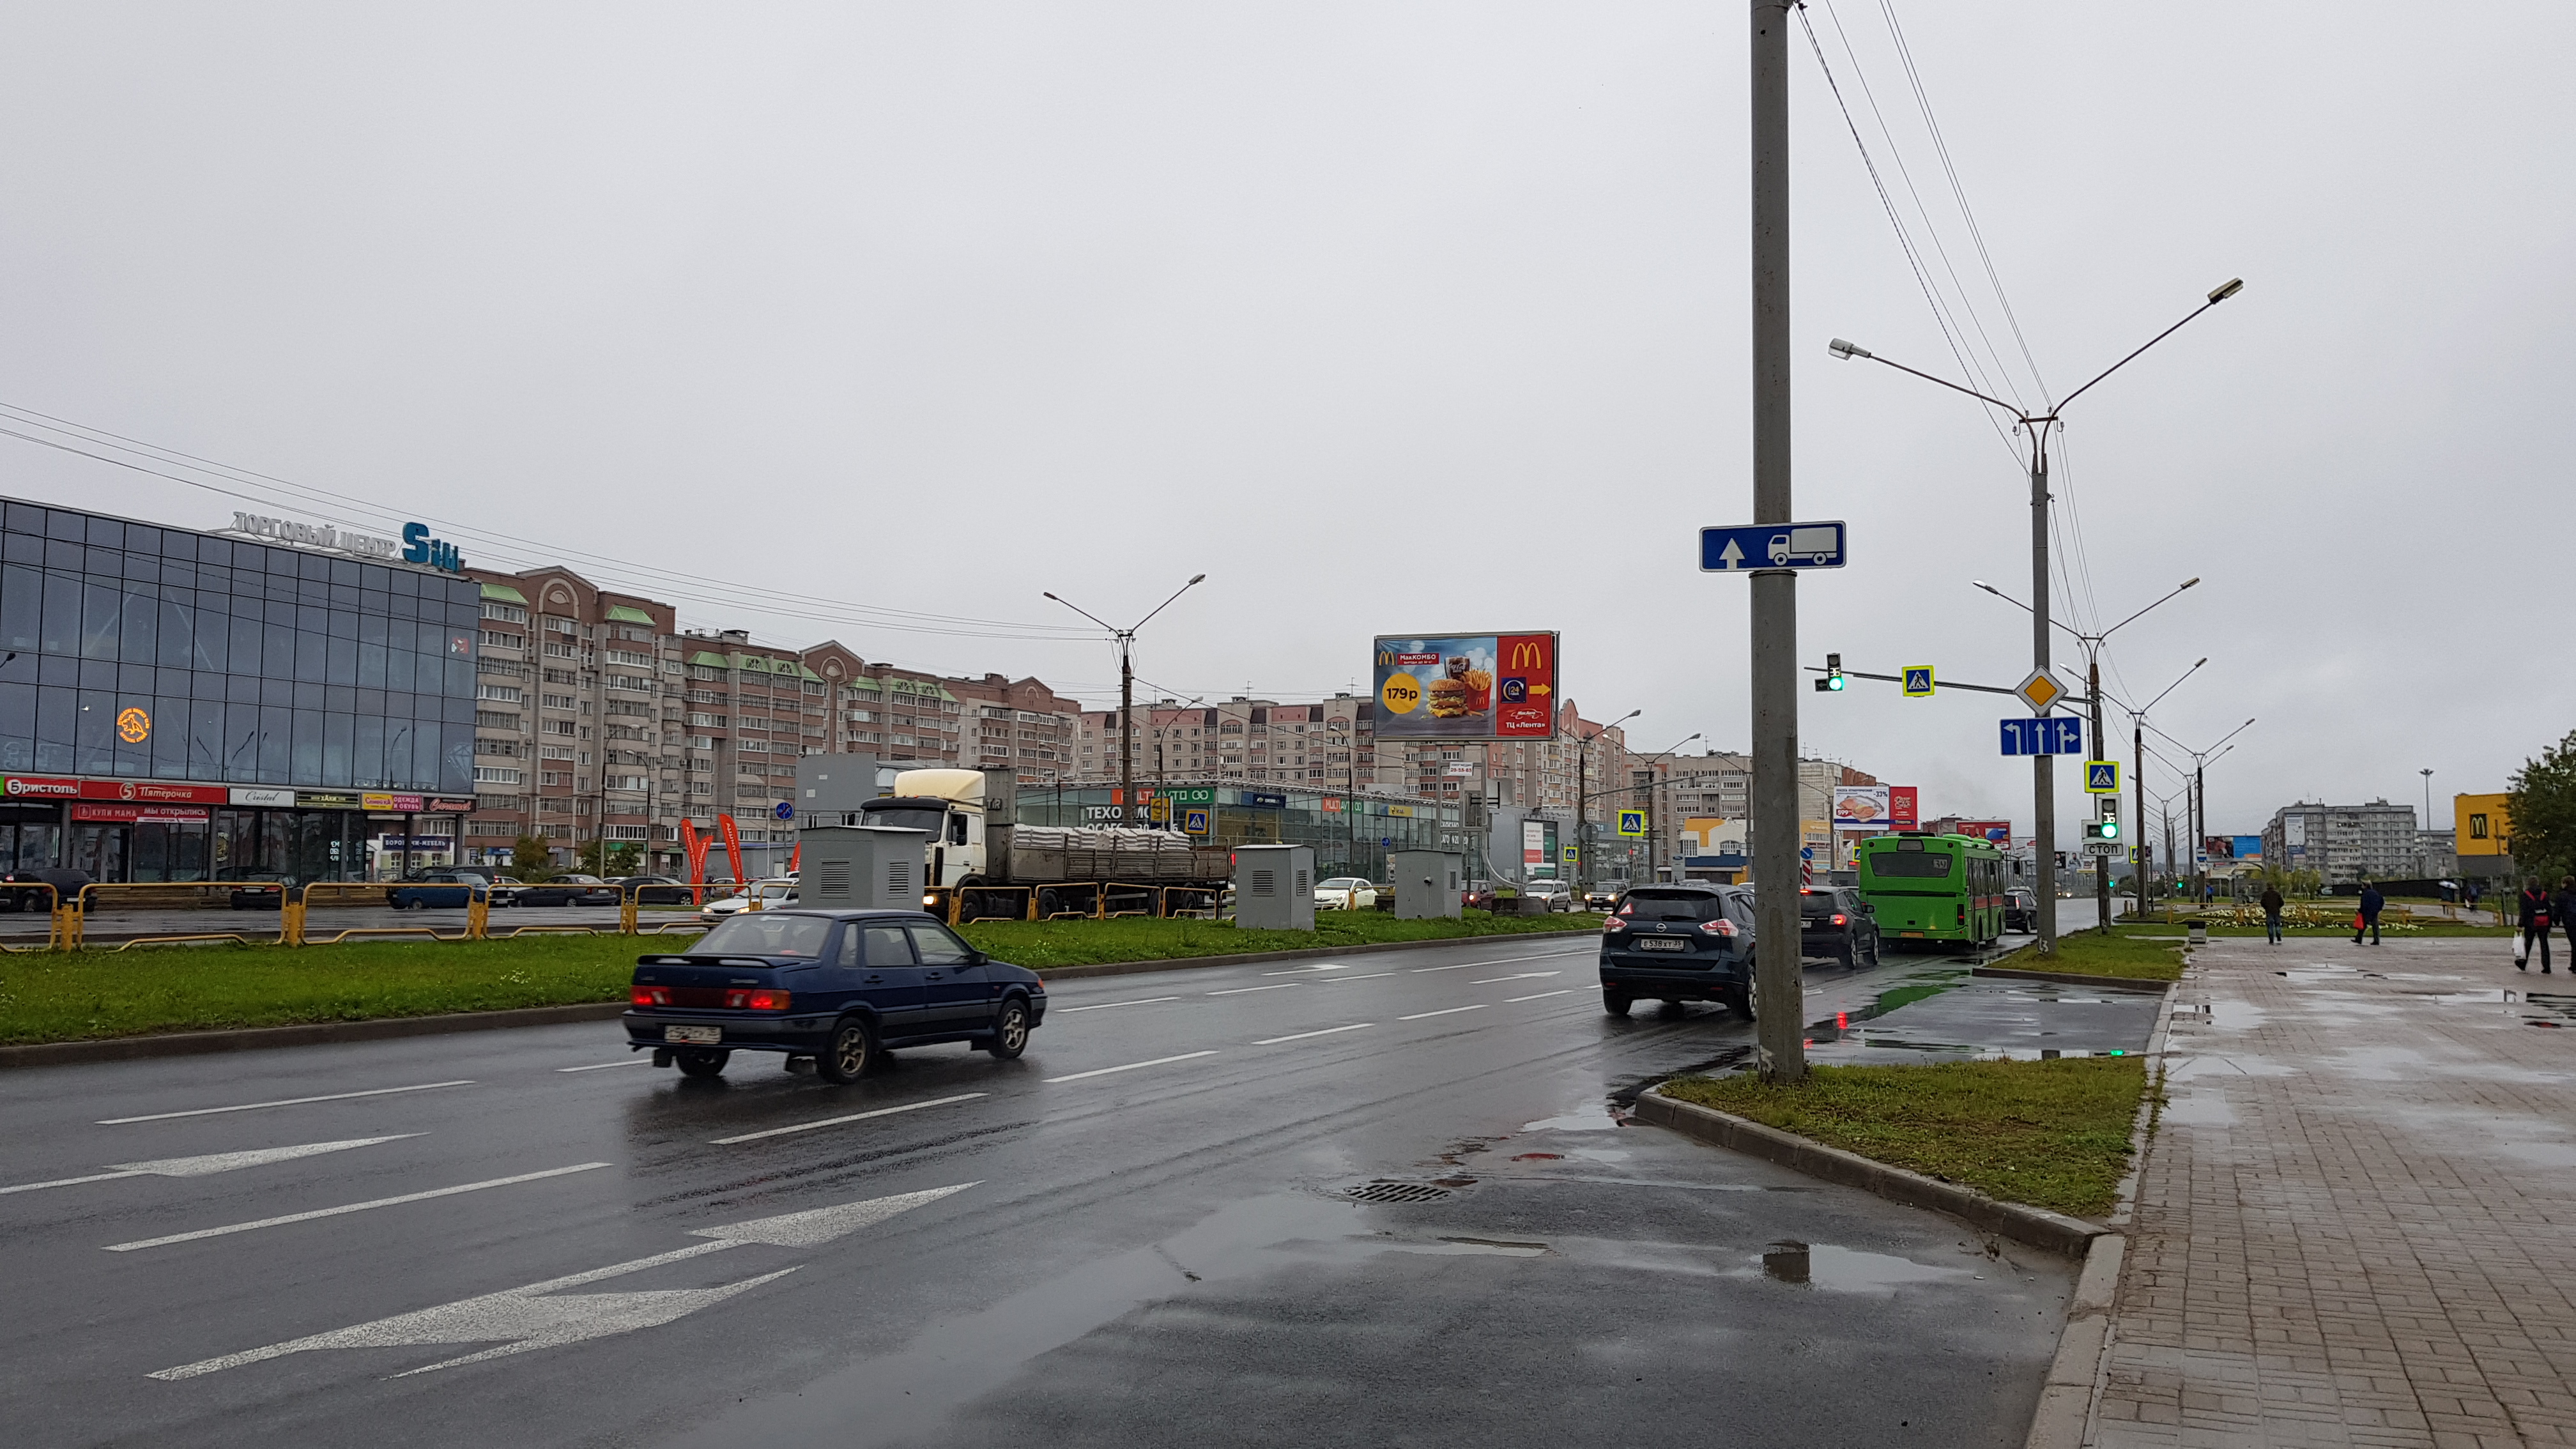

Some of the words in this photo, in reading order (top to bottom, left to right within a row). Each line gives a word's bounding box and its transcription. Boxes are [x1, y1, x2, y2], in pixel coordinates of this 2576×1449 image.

[233, 511, 337, 547] ТОРГОВЫЙ
[340, 531, 397, 558] ЦЕНТР
[6, 779, 78, 795] Бристоль
[138, 786, 192, 800] Пятерочка
[2089, 845, 2118, 854] СТОП
